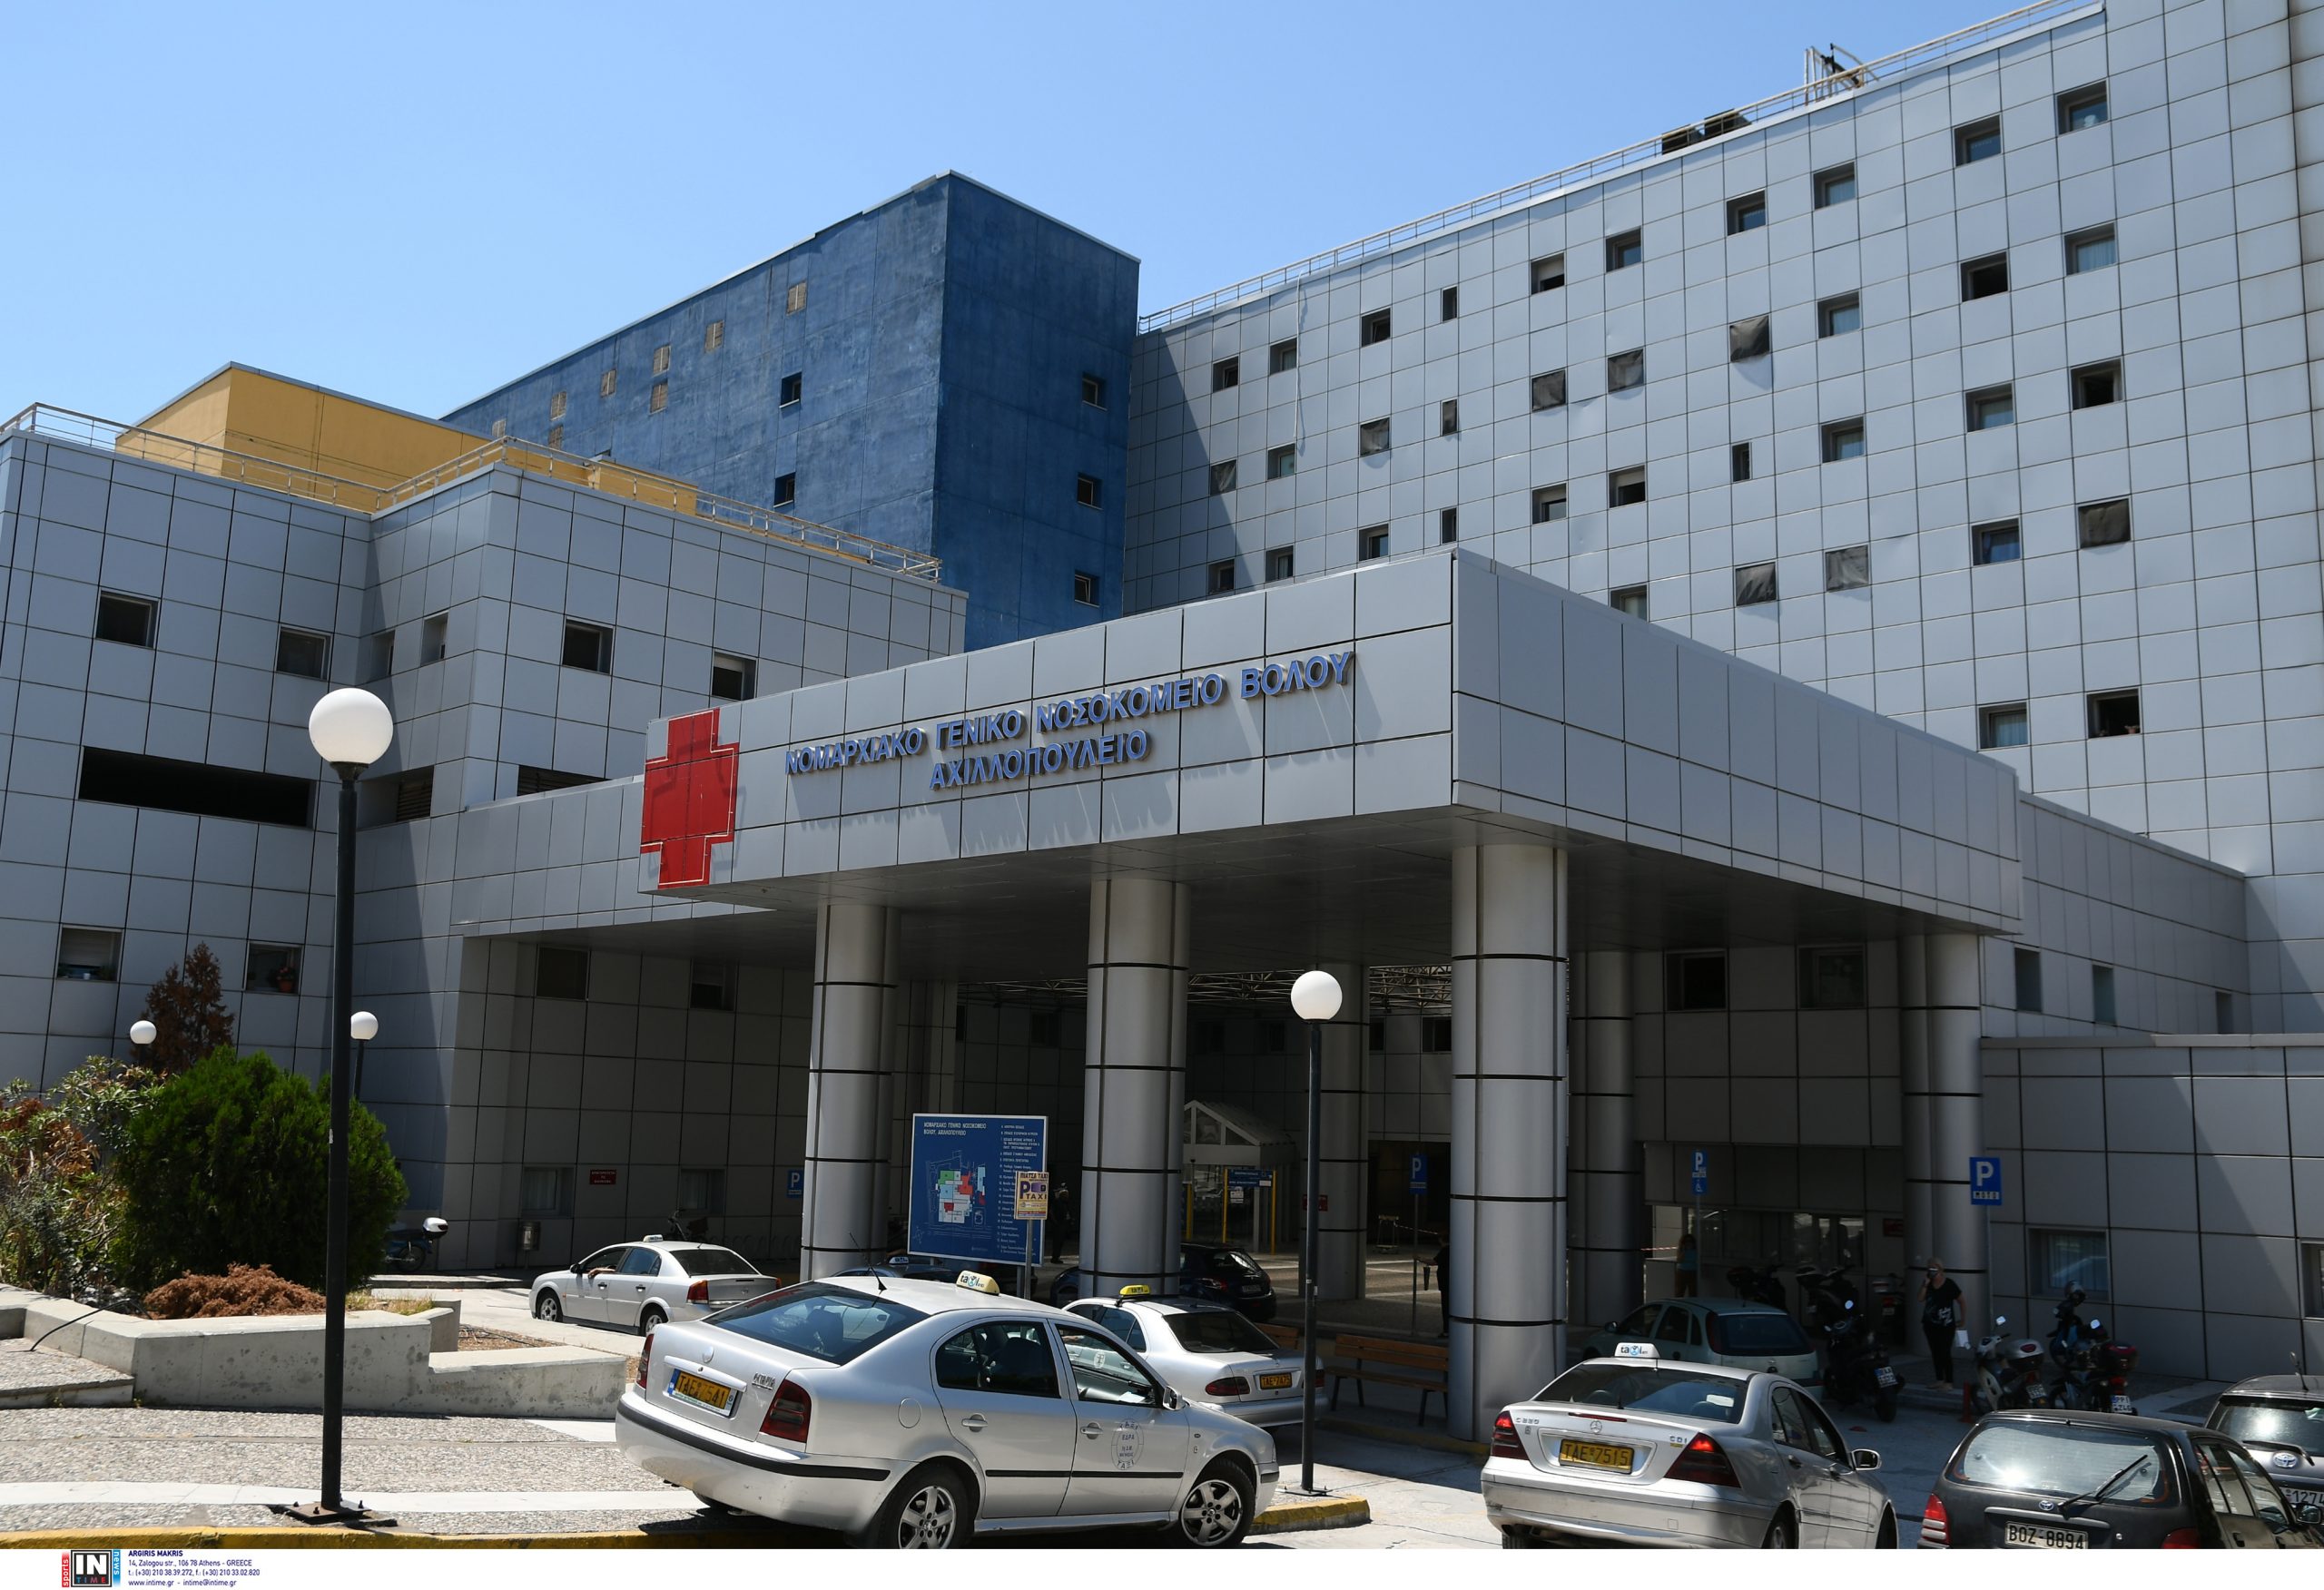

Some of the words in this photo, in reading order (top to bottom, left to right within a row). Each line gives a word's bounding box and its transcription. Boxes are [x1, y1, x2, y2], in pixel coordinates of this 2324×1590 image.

[785, 727, 926, 775] ΝΟΜΑΡΧΙΑΚΟ
[935, 710, 1026, 750] ΓΕΝΙΚΟ
[1036, 673, 1226, 734] ΝΟΣΟΚΟΜΕΙΟ
[1240, 652, 1353, 700] ΒΟΛΟΥ
[929, 729, 1151, 790] ΑΧΙΛΛΟΠΟΥΛΕΙΟ
[1413, 1158, 1422, 1179] P
[1696, 1153, 1703, 1171] P
[792, 1173, 800, 1188] P
[1977, 1162, 1994, 1186] P
[1020, 1181, 1030, 1199] P
